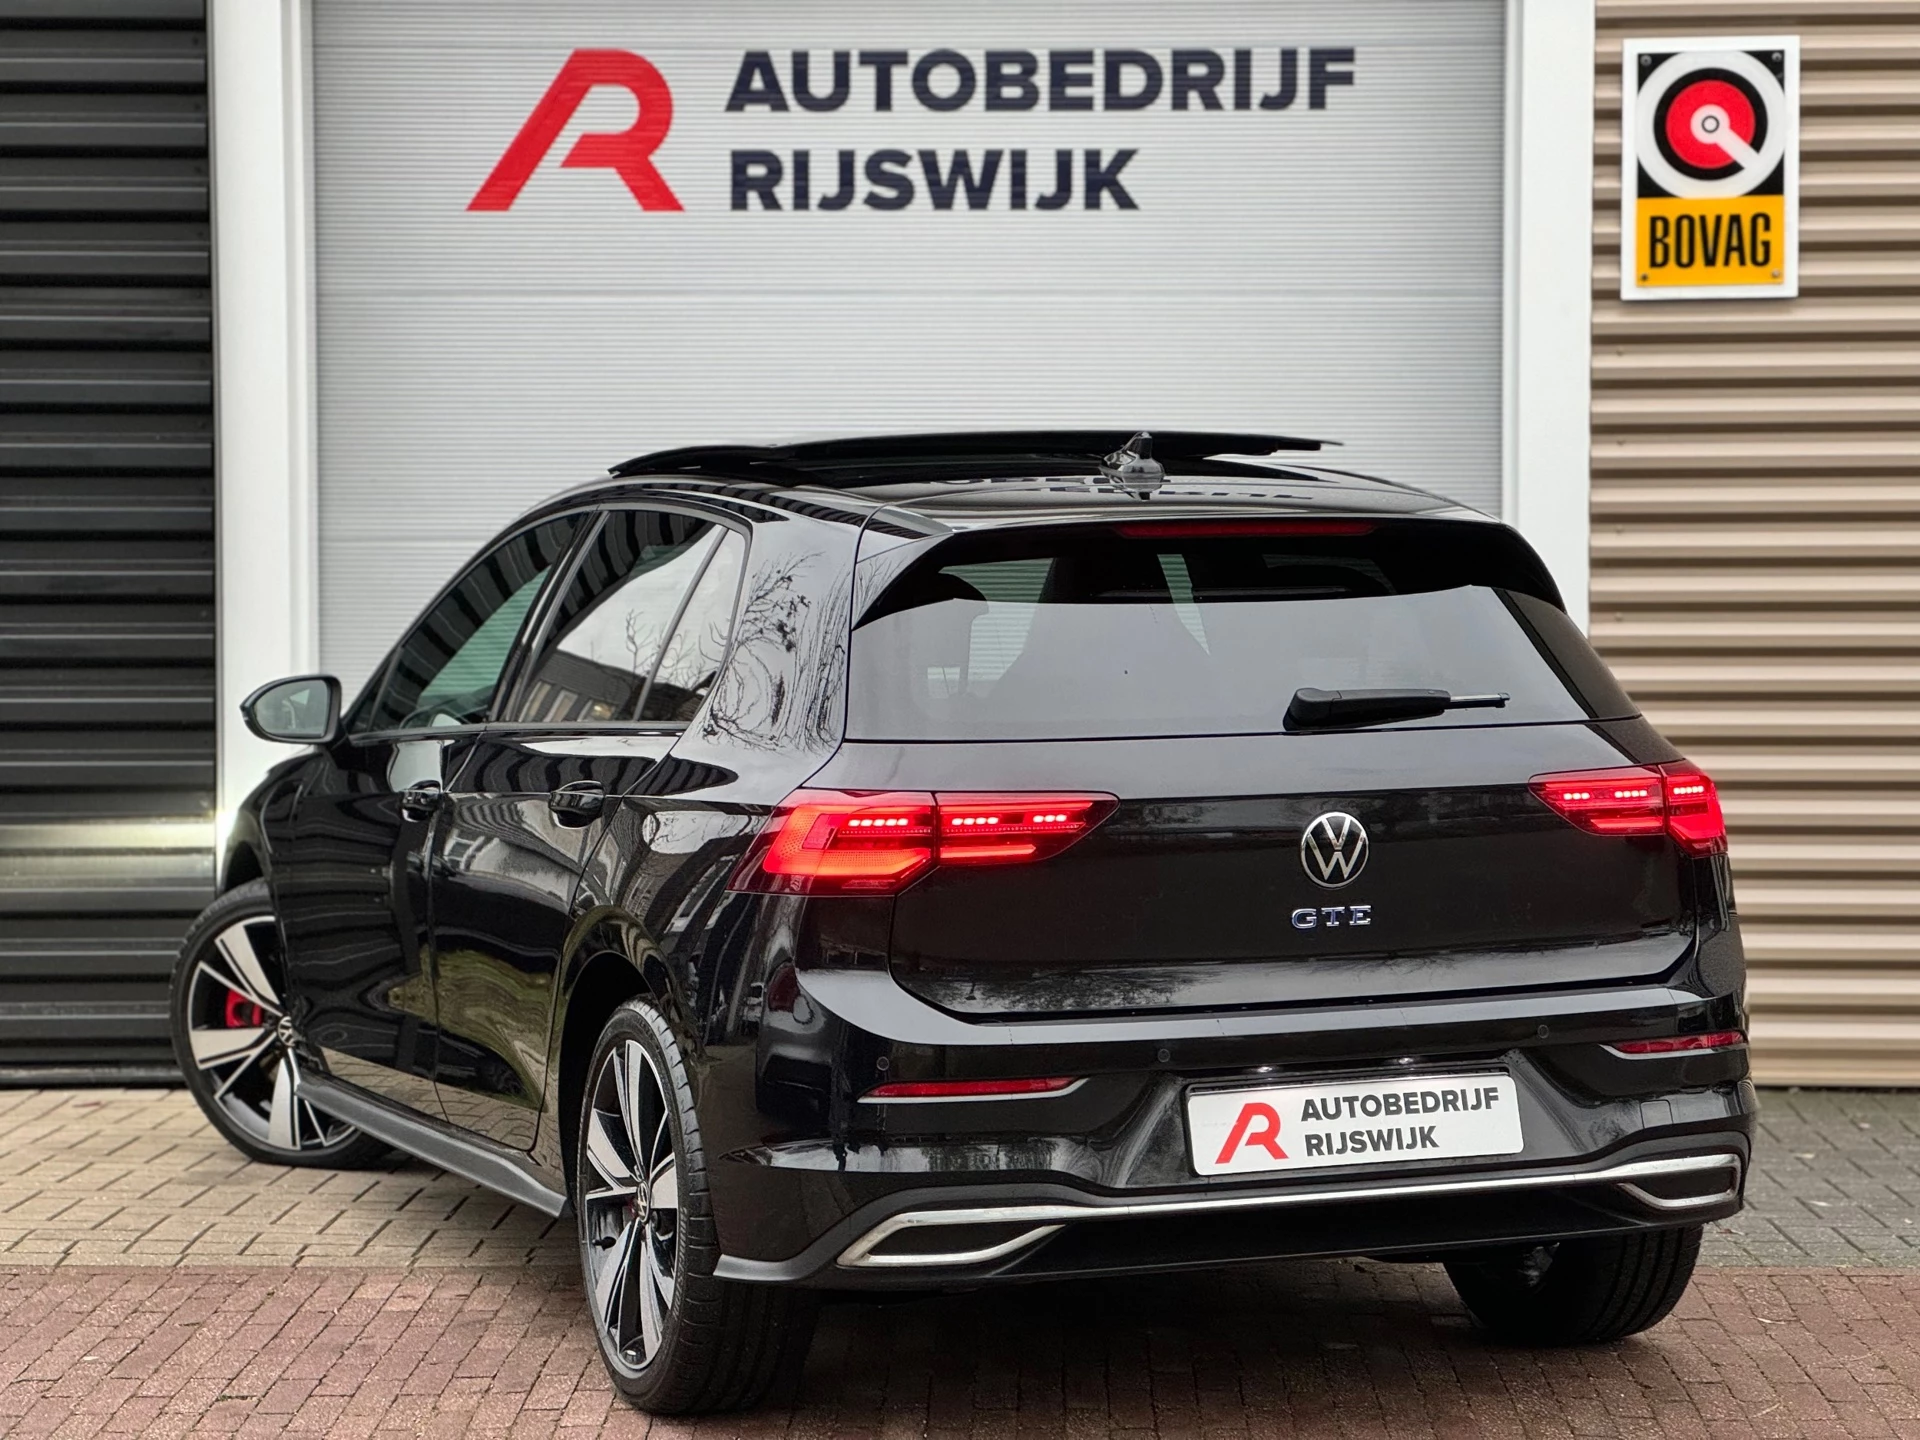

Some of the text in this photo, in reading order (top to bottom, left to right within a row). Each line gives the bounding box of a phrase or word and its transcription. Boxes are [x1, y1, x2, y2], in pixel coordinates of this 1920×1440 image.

[726, 48, 1356, 113] AUTOBEDRIJF
[730, 149, 1140, 211] RIJSWIJK
[1649, 212, 1771, 269] BOVAG
[1291, 904, 1372, 929] GTE
[1301, 1087, 1499, 1122] AUTOBEDRIJF
[1304, 1126, 1439, 1157] RIJSWIJK
